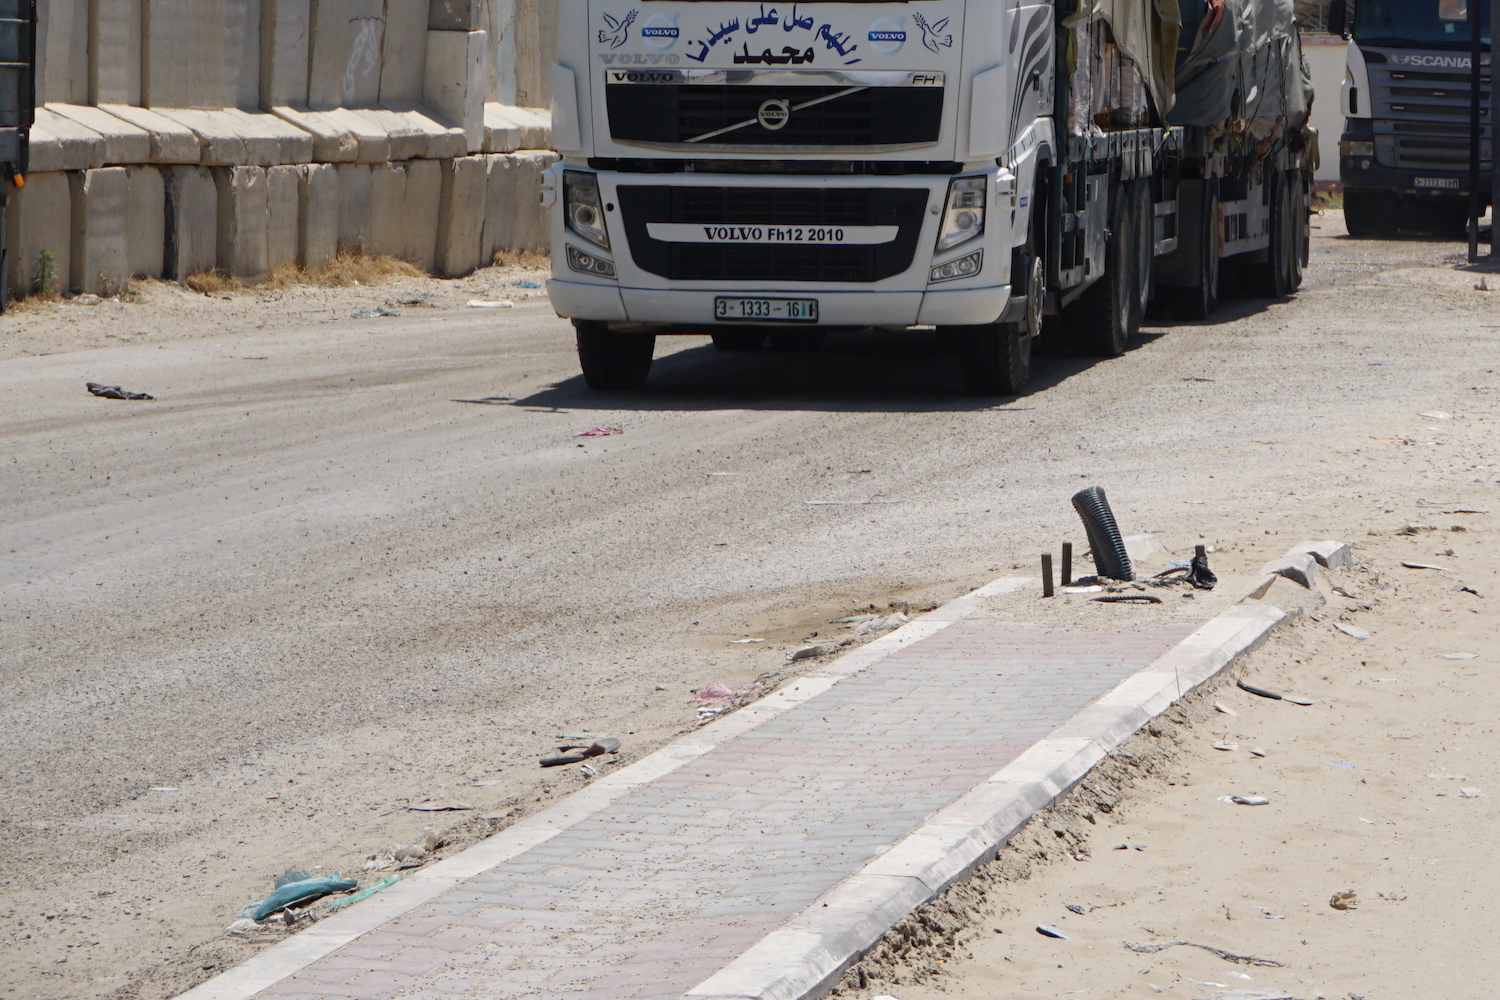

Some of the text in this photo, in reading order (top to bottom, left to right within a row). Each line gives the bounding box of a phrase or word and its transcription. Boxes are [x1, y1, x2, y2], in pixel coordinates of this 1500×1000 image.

[745, 2, 779, 34] على
[783, 2, 814, 32] صل
[644, 28, 678, 37] VOLVO
[870, 32, 905, 40] VOLVO
[814, 23, 862, 65] اللهم
[599, 53, 681, 65] VOLVO
[733, 40, 815, 66] محمد
[1410, 54, 1472, 69] SCANIA
[612, 72, 674, 82] VOLVO
[912, 75, 936, 85] FH
[703, 226, 844, 241] VOLVO Fh12 2010
